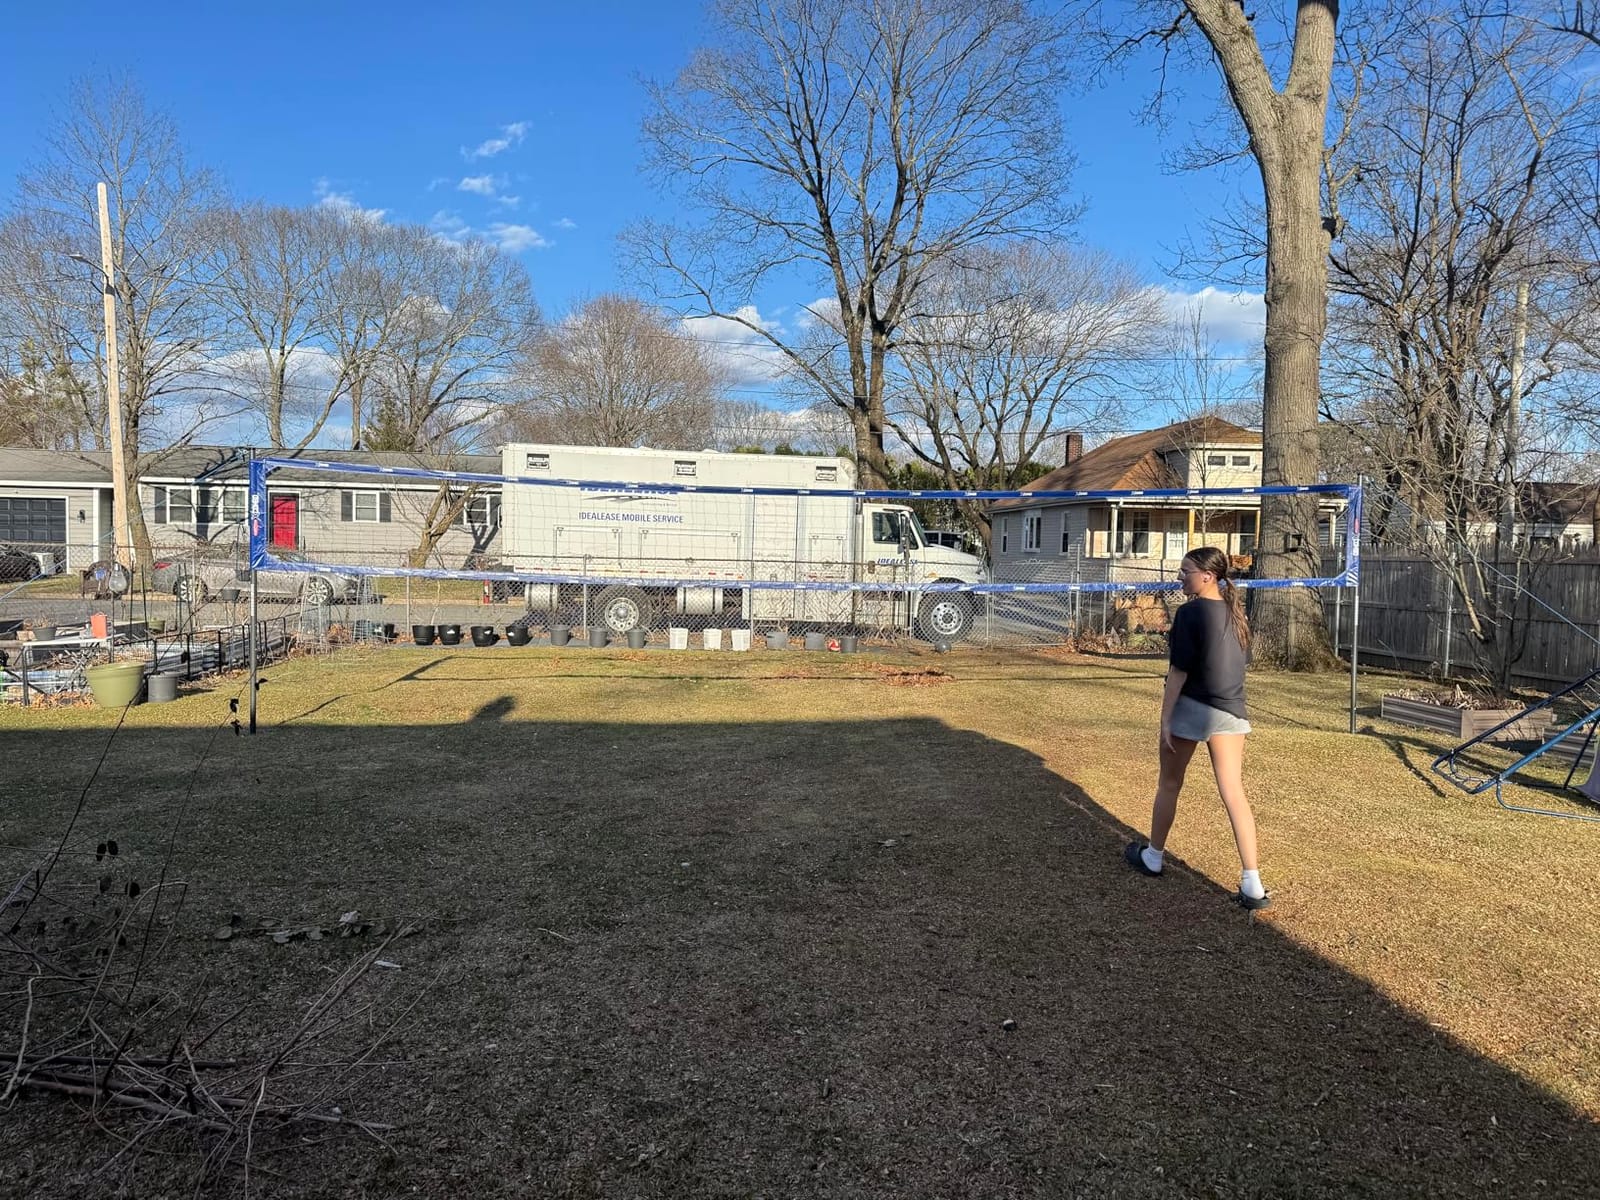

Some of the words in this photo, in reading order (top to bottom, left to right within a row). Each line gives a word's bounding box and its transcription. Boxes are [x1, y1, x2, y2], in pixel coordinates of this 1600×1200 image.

[579, 511, 621, 521] IDEALEASE
[622, 513, 652, 522] MOBILE
[653, 514, 684, 523] SERVICE
